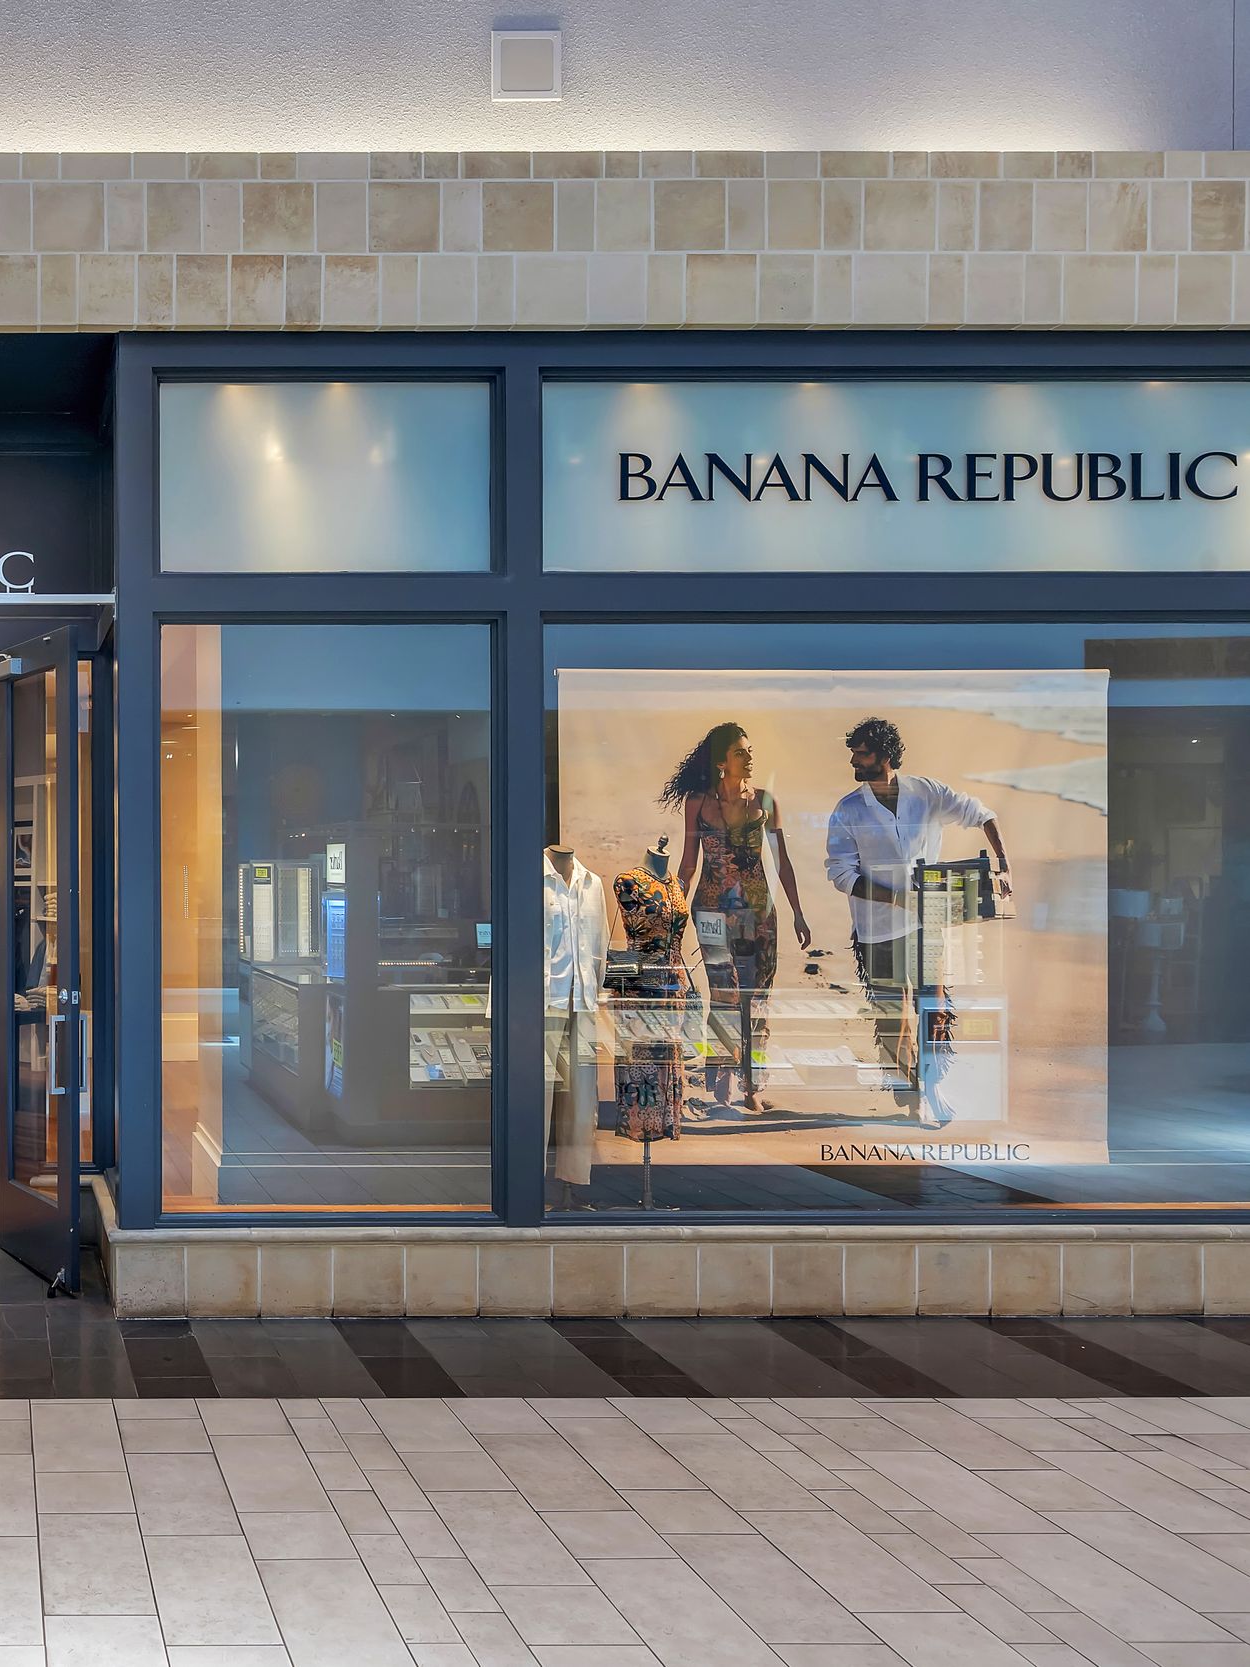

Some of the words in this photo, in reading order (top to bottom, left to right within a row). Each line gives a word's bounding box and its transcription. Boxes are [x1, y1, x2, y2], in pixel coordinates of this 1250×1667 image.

[618, 452, 900, 502] BANANA
[917, 451, 1239, 502] REPUBLIC
[820, 1144, 916, 1161] BANANA
[922, 1143, 1030, 1161] REPUBLIC
